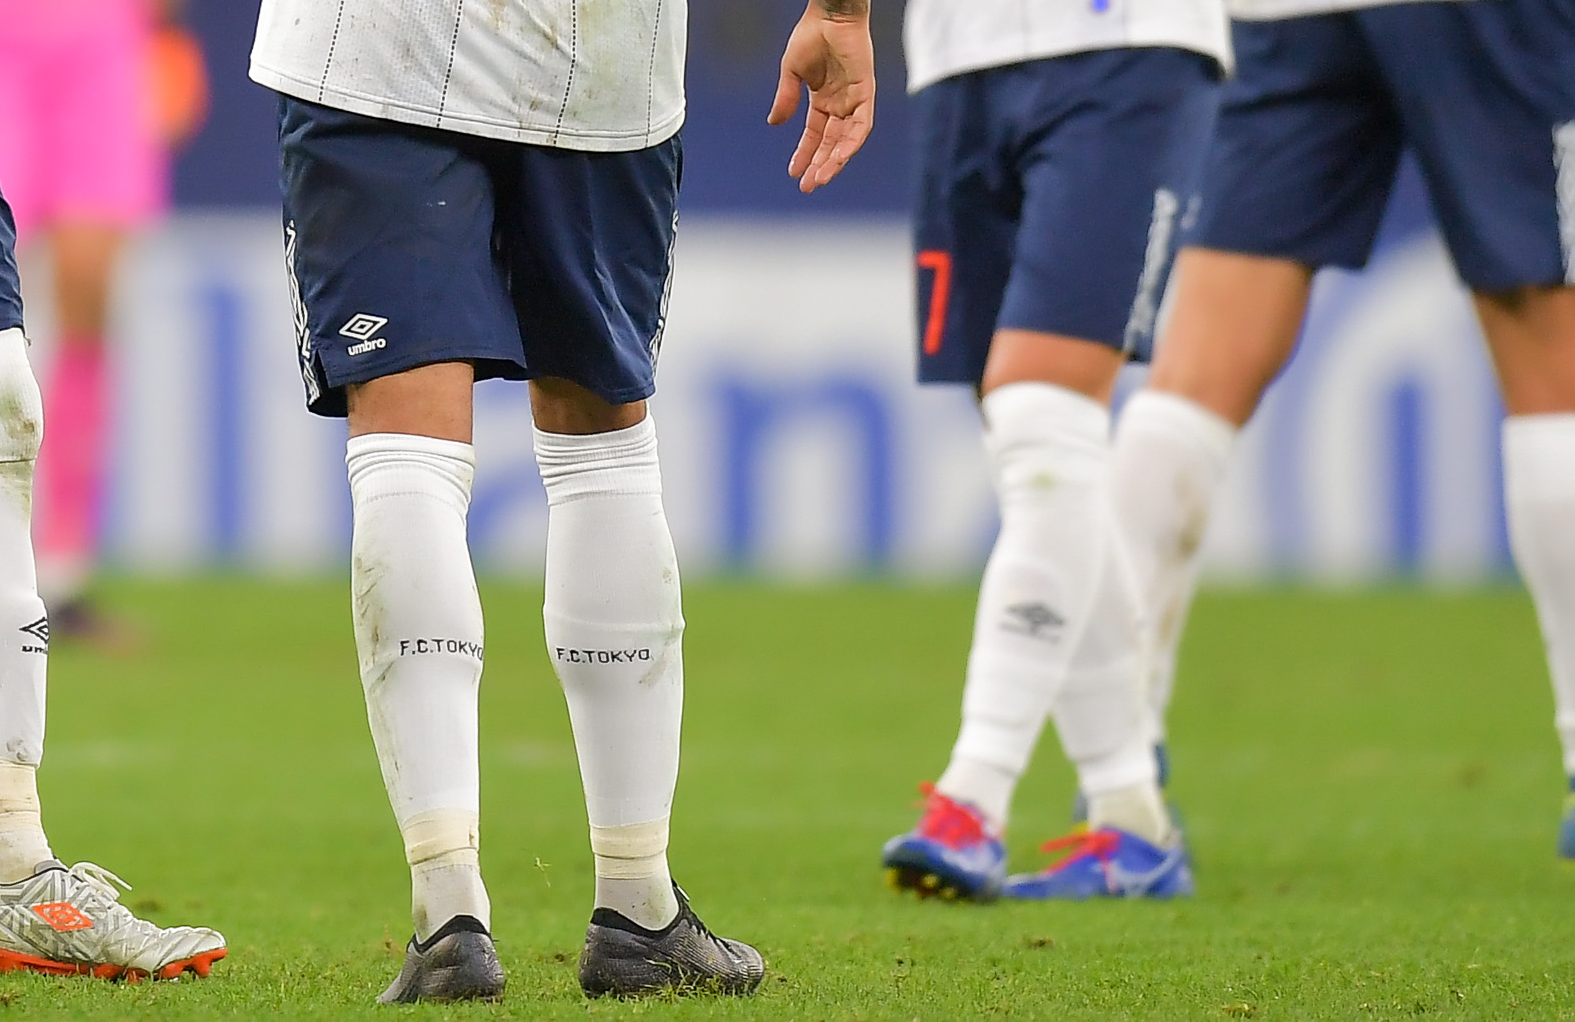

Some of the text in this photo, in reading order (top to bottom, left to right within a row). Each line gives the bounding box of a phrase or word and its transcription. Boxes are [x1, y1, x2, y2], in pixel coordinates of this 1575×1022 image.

[916, 251, 952, 355] 7
[347, 338, 387, 356] umbro
[400, 639, 484, 661] F.C.TOKYO
[556, 647, 650, 664] F.C.TOKYO
